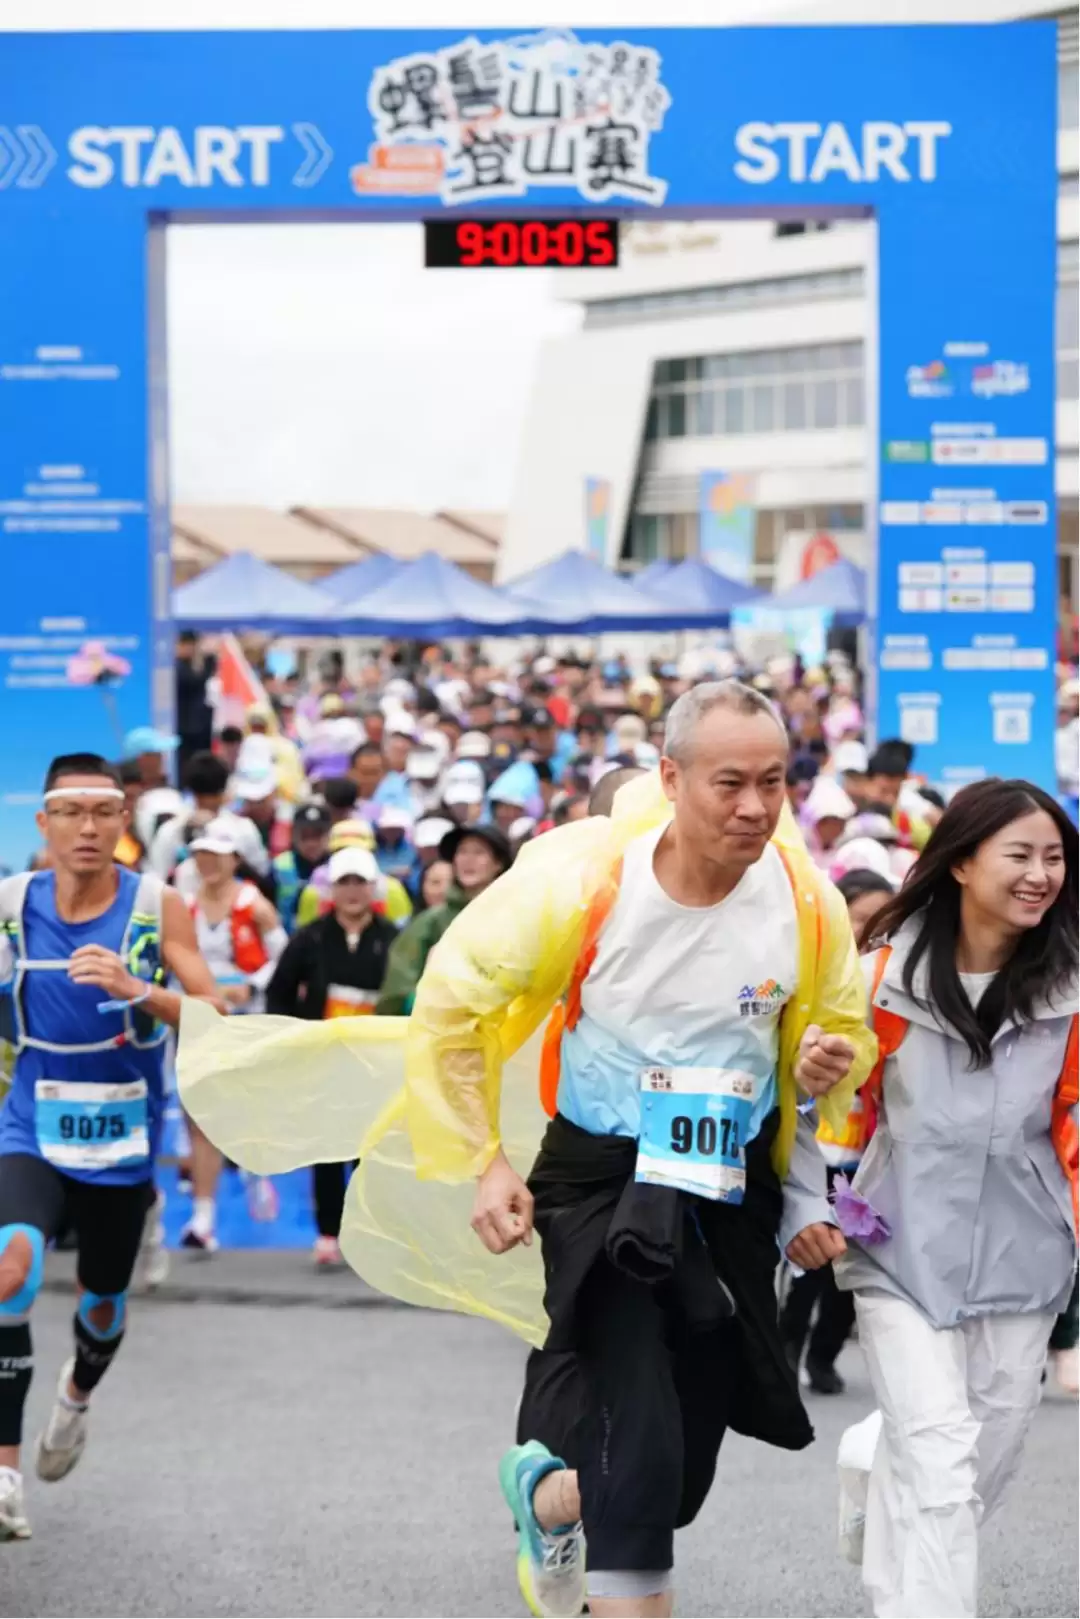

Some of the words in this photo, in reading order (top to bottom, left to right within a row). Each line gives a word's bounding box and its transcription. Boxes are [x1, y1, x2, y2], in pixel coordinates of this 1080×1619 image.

[67, 125, 284, 188] START
[450, 116, 656, 194] 登山赛
[733, 121, 952, 184] START
[456, 221, 614, 266] 9:00:05
[59, 1113, 126, 1140] 9075
[670, 1115, 740, 1159] 9073
